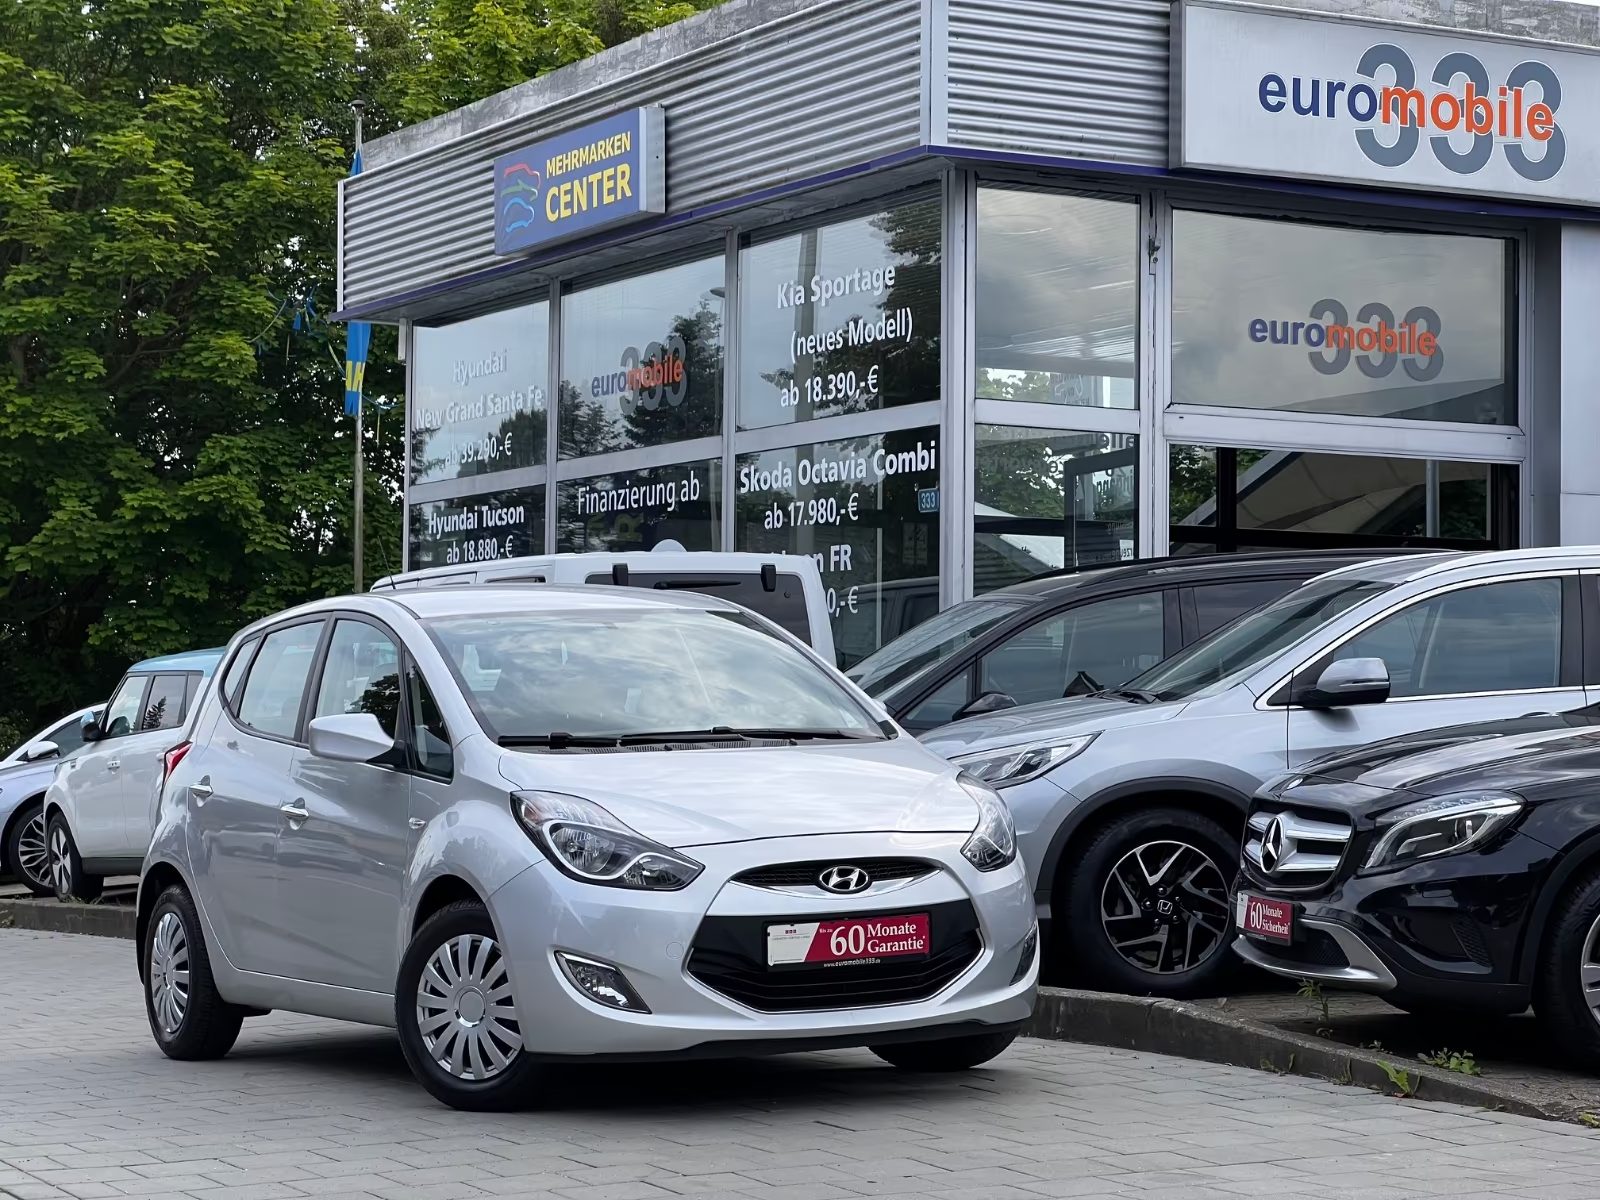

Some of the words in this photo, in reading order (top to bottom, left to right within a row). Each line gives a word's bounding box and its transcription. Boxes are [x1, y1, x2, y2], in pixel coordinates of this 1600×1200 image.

[1258, 72, 1555, 141] euromobile
[1354, 42, 1567, 182] 333
[546, 131, 631, 179] MEHRMARKEN
[545, 163, 632, 222] CENTER
[777, 280, 805, 309] Kia
[810, 265, 896, 307] Sportage
[790, 331, 843, 364] (neues
[848, 307, 913, 347] Modell)
[1248, 317, 1437, 357] euromobile
[1308, 298, 1445, 382] 333
[453, 350, 506, 386] Hyundai
[591, 354, 683, 398] euromobile
[416, 408, 443, 430] New
[446, 394, 484, 423] Grand
[487, 389, 523, 416] Santa
[528, 385, 543, 408] Fe
[780, 379, 799, 407] ab
[445, 443, 459, 466] ab
[740, 461, 793, 494] Skoda
[798, 452, 867, 486] Octavia
[873, 440, 936, 476] Combi
[578, 480, 676, 515] Finanzierung
[680, 470, 700, 501] ab
[921, 492, 936, 509] 333
[428, 505, 478, 539] Hyundai
[481, 505, 525, 528] Tucson
[764, 502, 783, 530] ab
[446, 541, 460, 563] ab
[830, 544, 852, 572] FR
[1250, 901, 1263, 929] 60
[1262, 904, 1283, 918] Monate
[830, 925, 866, 956] 60
[867, 922, 917, 938] Monate
[867, 937, 924, 954] Garantie
